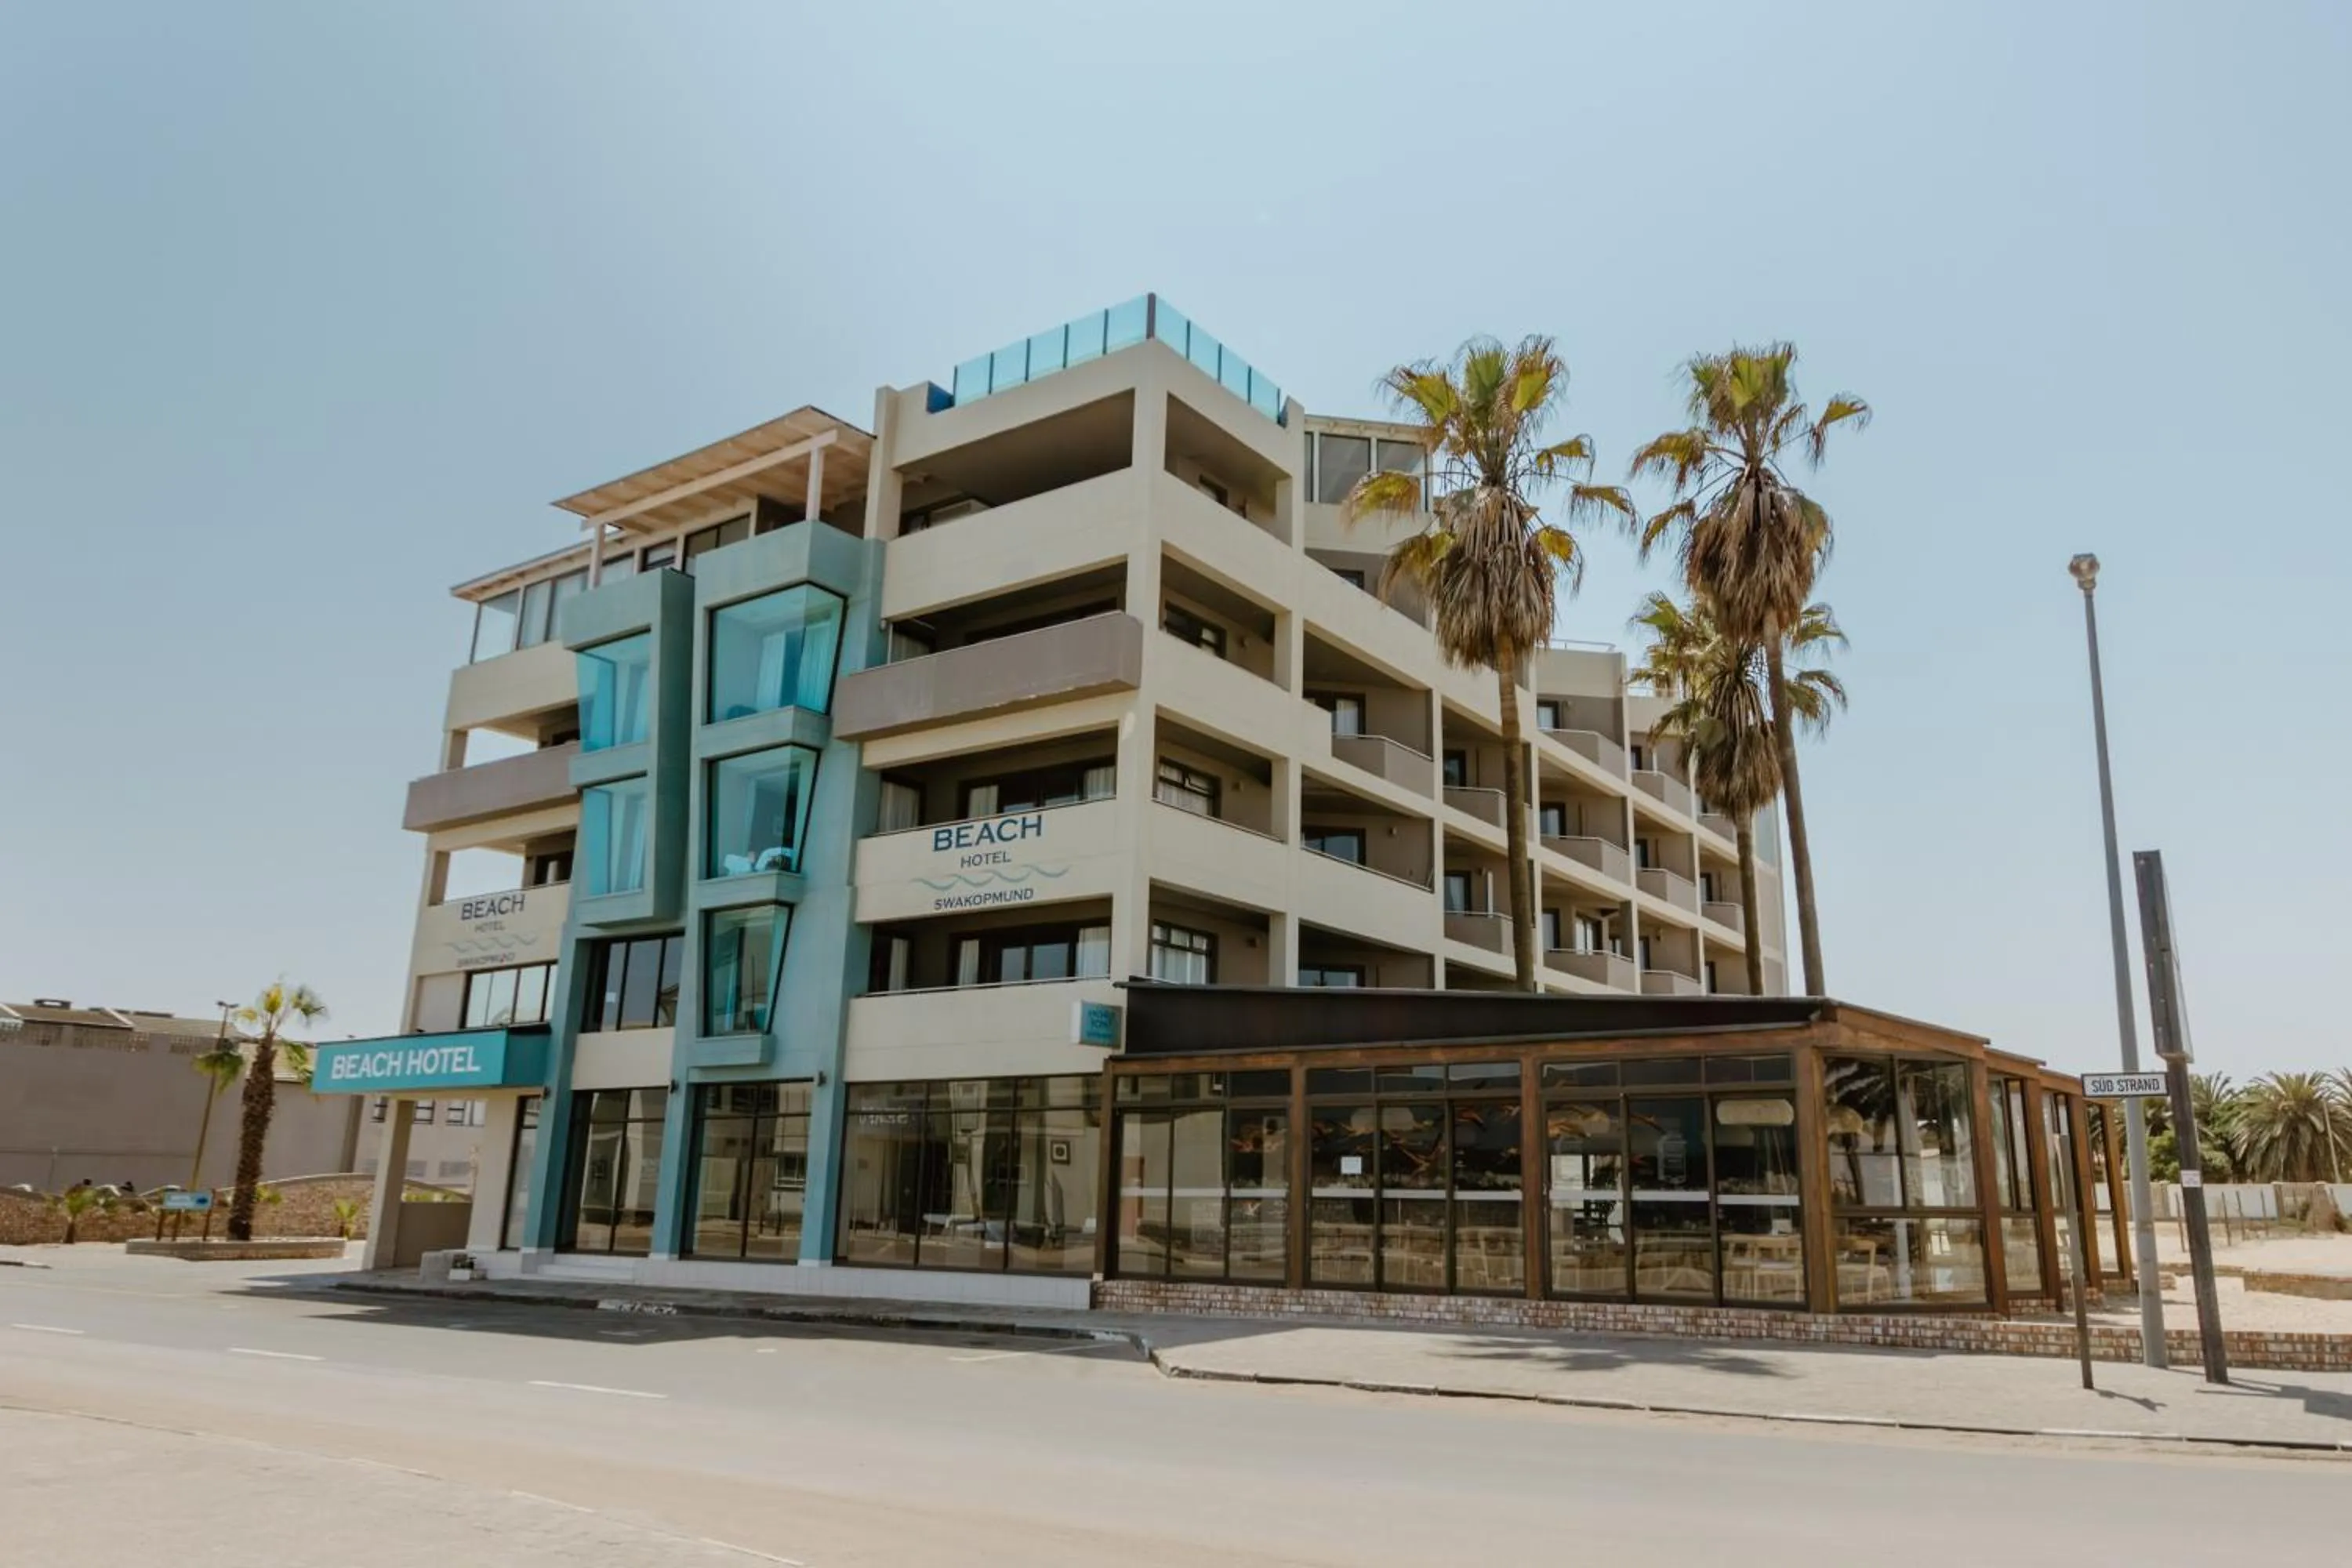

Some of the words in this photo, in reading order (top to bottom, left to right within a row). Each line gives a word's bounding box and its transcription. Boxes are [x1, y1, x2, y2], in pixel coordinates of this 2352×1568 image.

[933, 815, 1042, 851] BEACH
[960, 851, 1011, 868] HOTEL
[461, 894, 524, 920] BEACH
[934, 888, 1033, 910] SWAKOPMUND
[331, 1051, 403, 1080] BEACH
[406, 1046, 481, 1075] HOTEL
[2091, 1077, 2114, 1092] SÜD
[2118, 1078, 2160, 1092] STRAND
